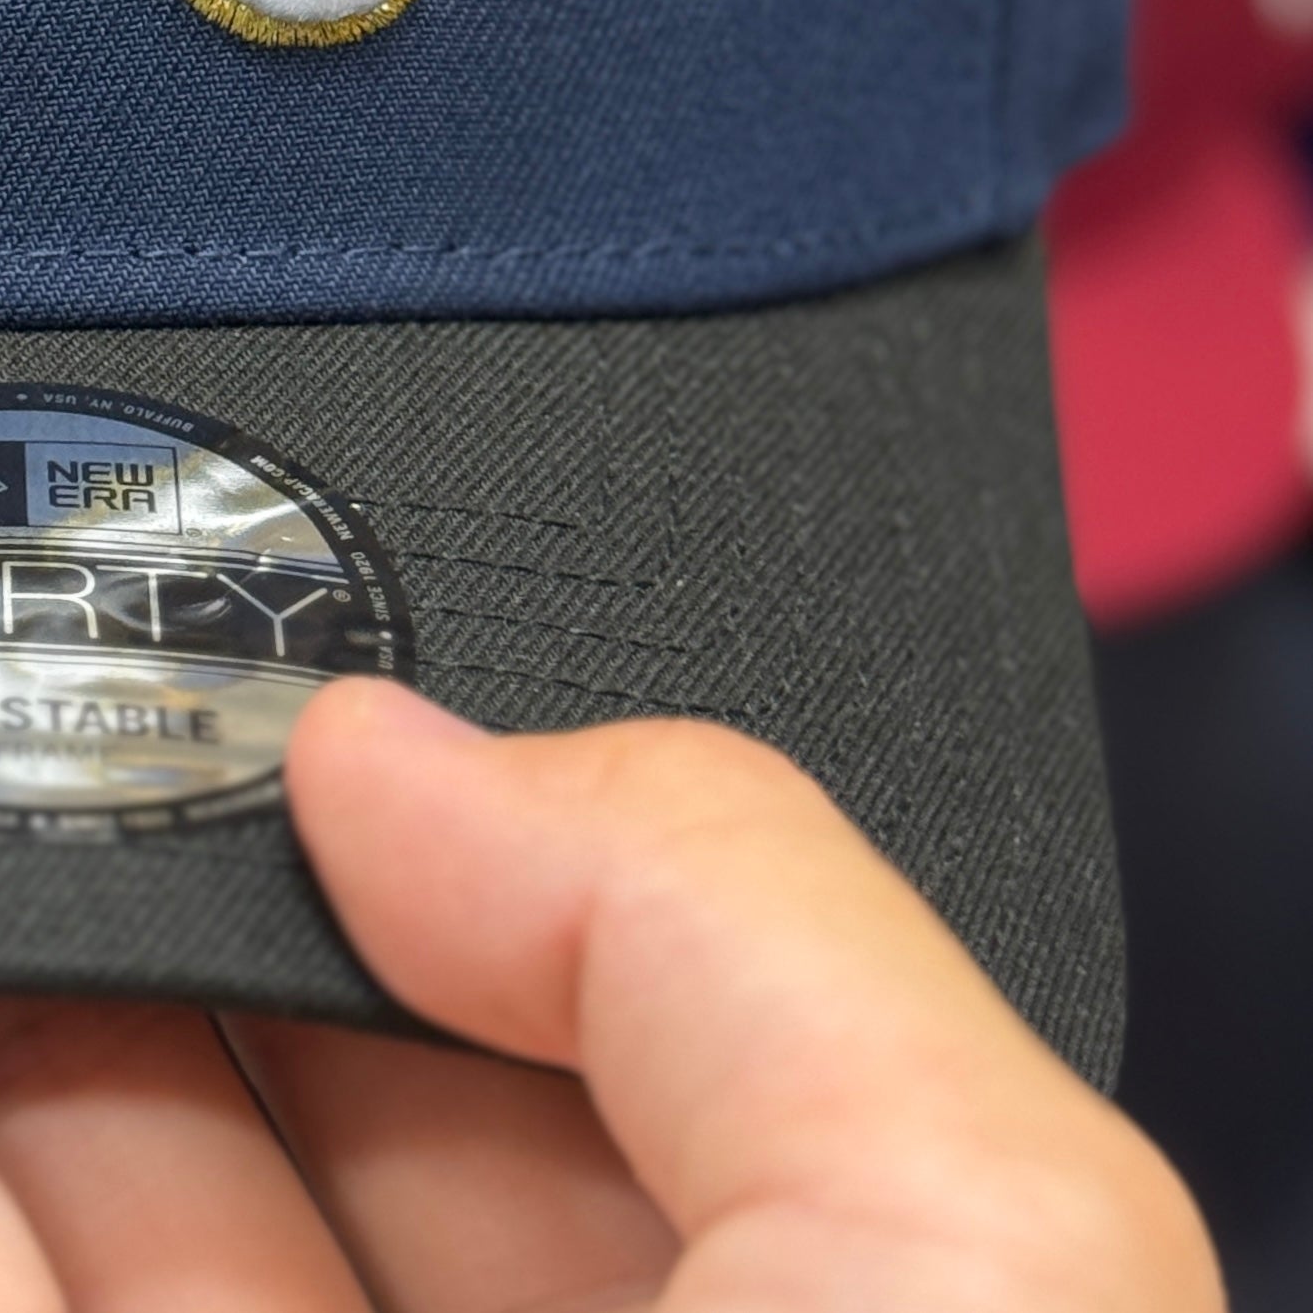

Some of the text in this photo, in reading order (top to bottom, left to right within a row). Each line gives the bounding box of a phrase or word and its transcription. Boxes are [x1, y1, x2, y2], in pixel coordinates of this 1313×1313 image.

[43, 393, 77, 404] USA
[47, 460, 154, 487] NEW
[49, 485, 156, 513] ERA
[249, 454, 396, 671] USA SINCE 1920 NEWERACAP.COM
